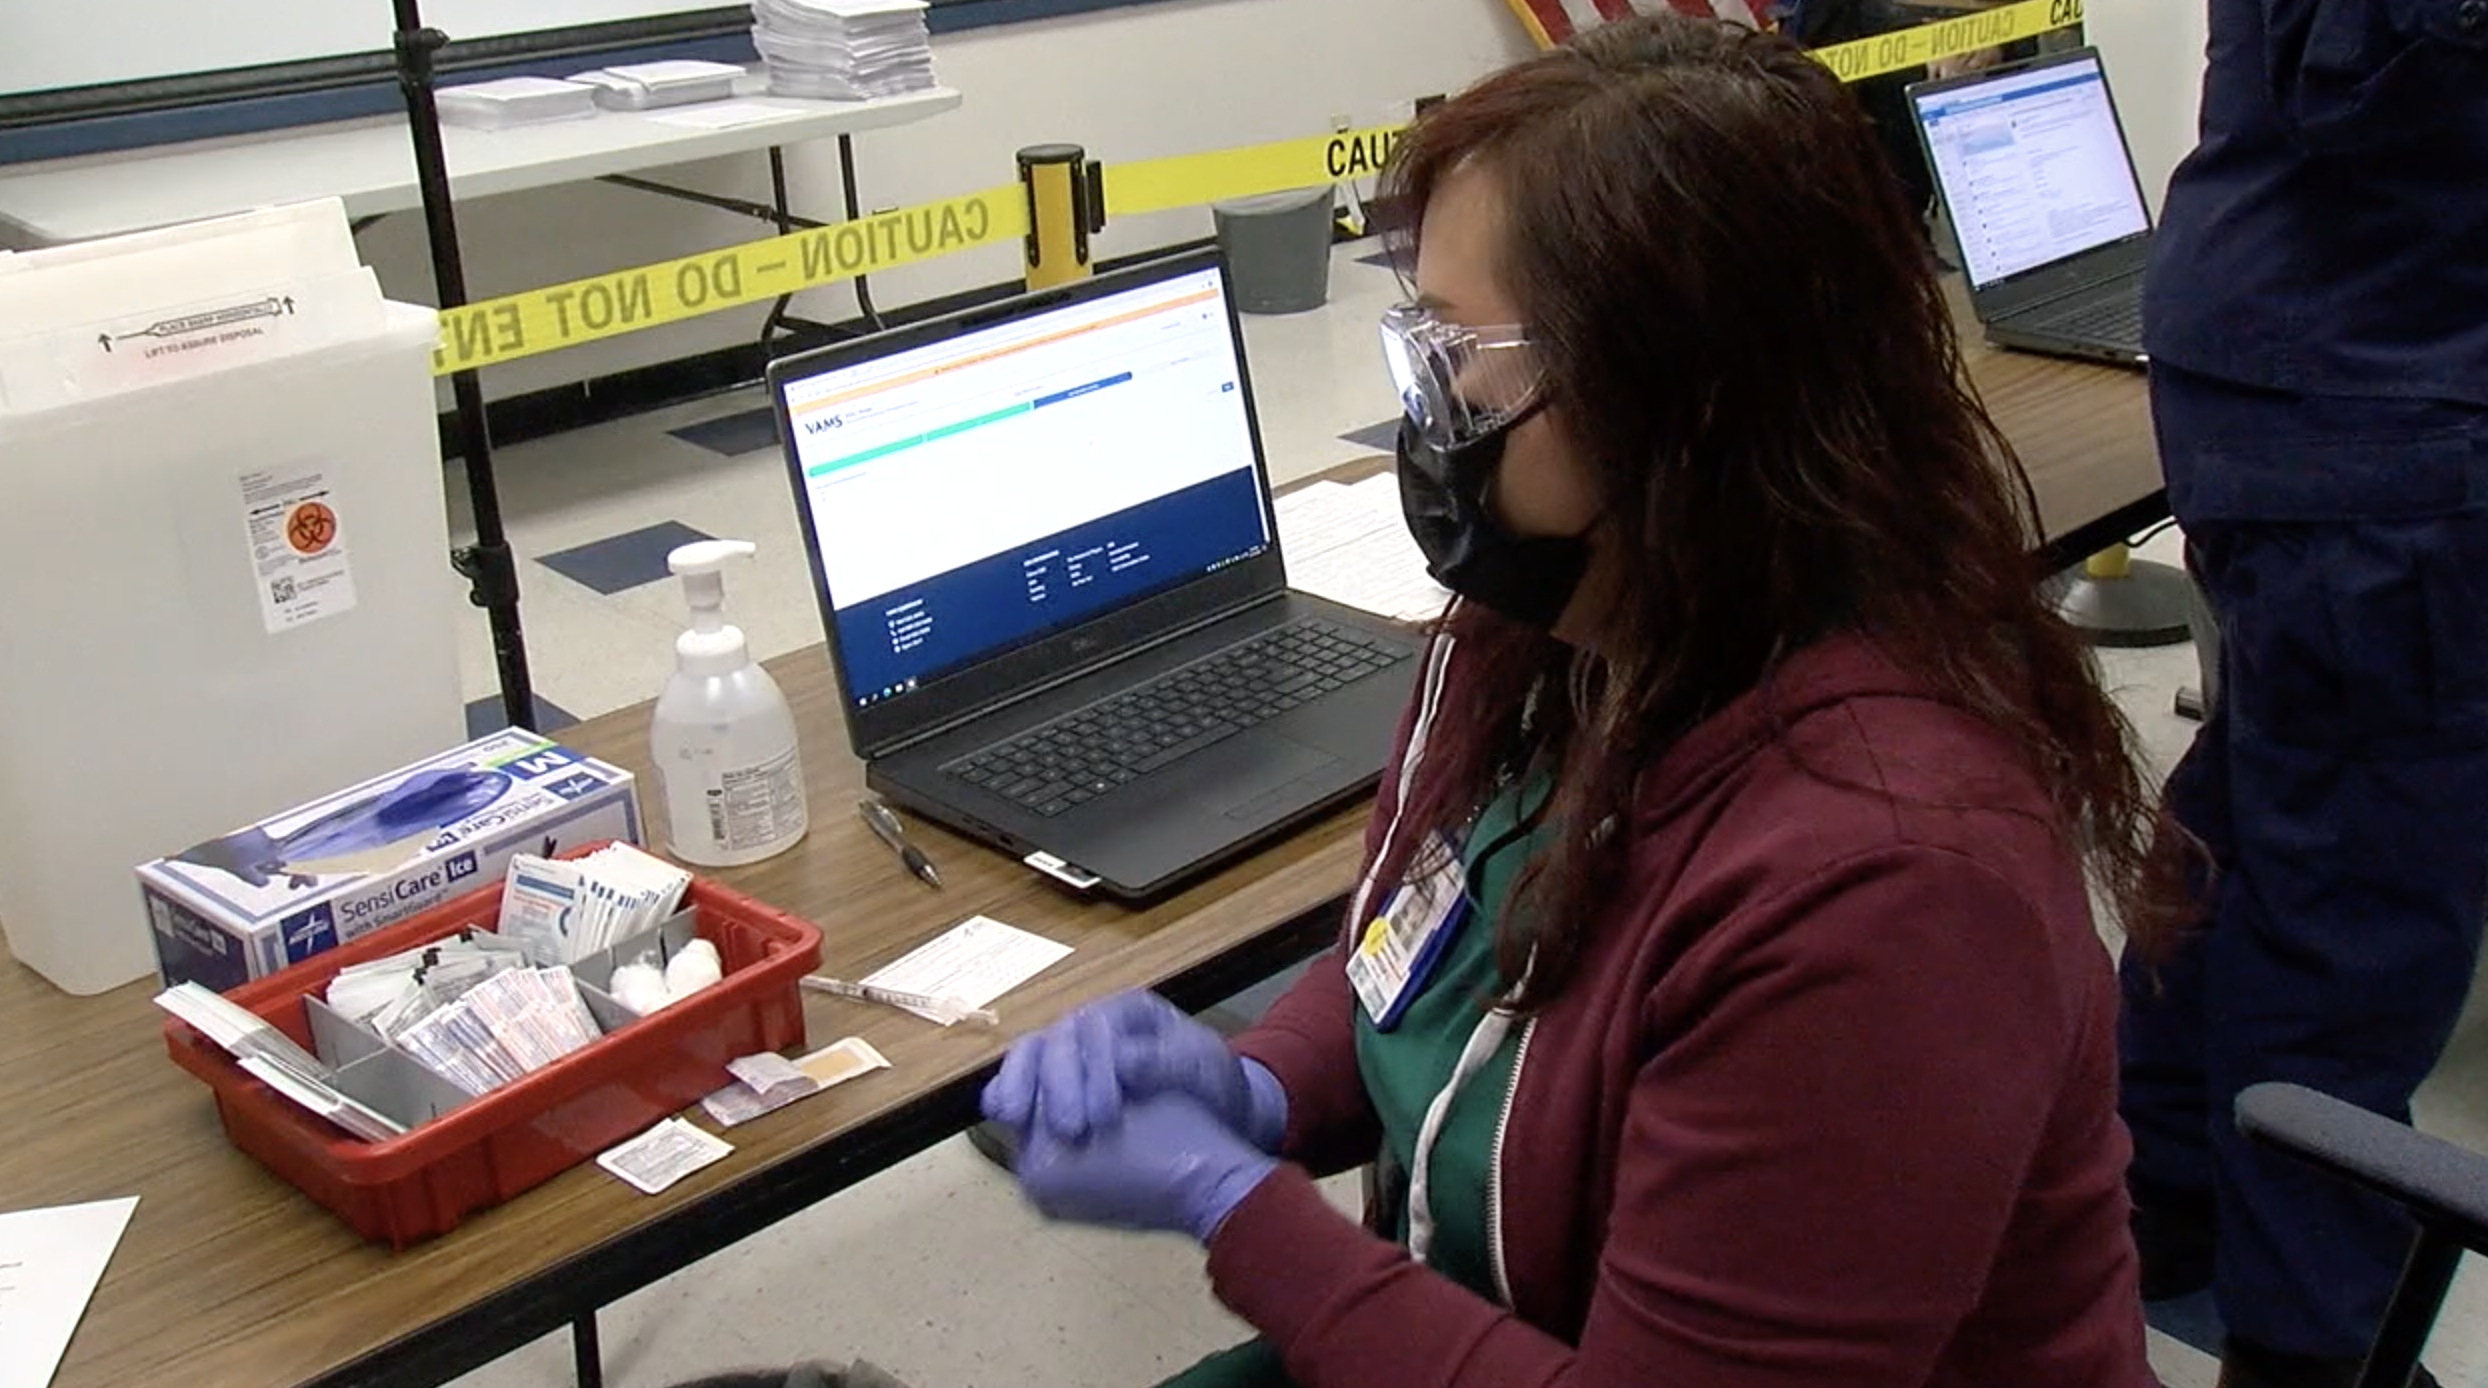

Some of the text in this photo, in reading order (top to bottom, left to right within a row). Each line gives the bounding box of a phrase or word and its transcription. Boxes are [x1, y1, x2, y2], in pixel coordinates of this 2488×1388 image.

[1327, 131, 1398, 177] CAU
[804, 414, 843, 435] VAMS
[450, 859, 473, 877] Ice
